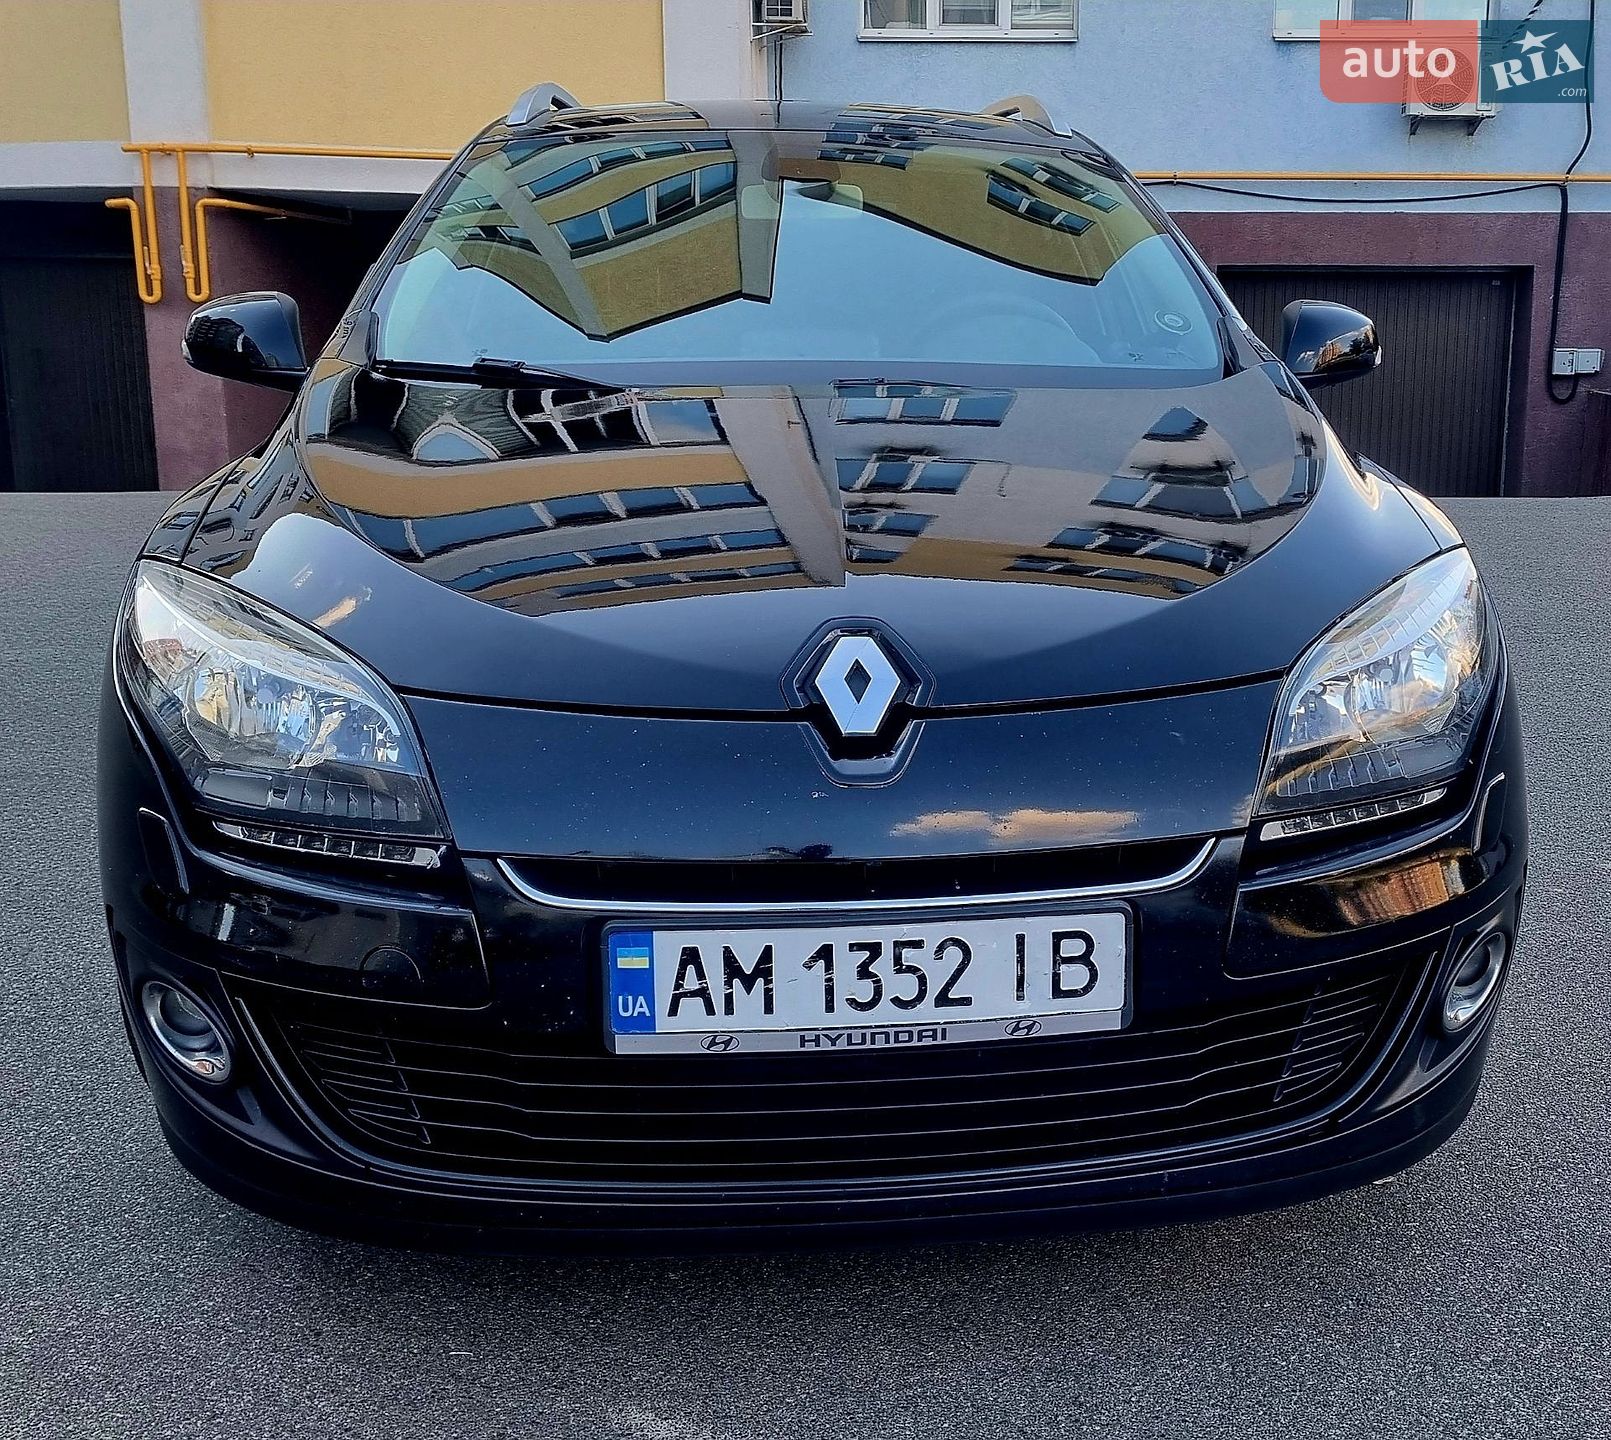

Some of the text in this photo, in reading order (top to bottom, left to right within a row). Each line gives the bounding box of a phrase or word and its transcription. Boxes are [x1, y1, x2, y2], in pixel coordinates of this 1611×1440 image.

[666, 929, 1099, 1018] AM 1352 IB
[617, 994, 650, 1018] UA
[799, 1026, 947, 1049] HYUNDAI
